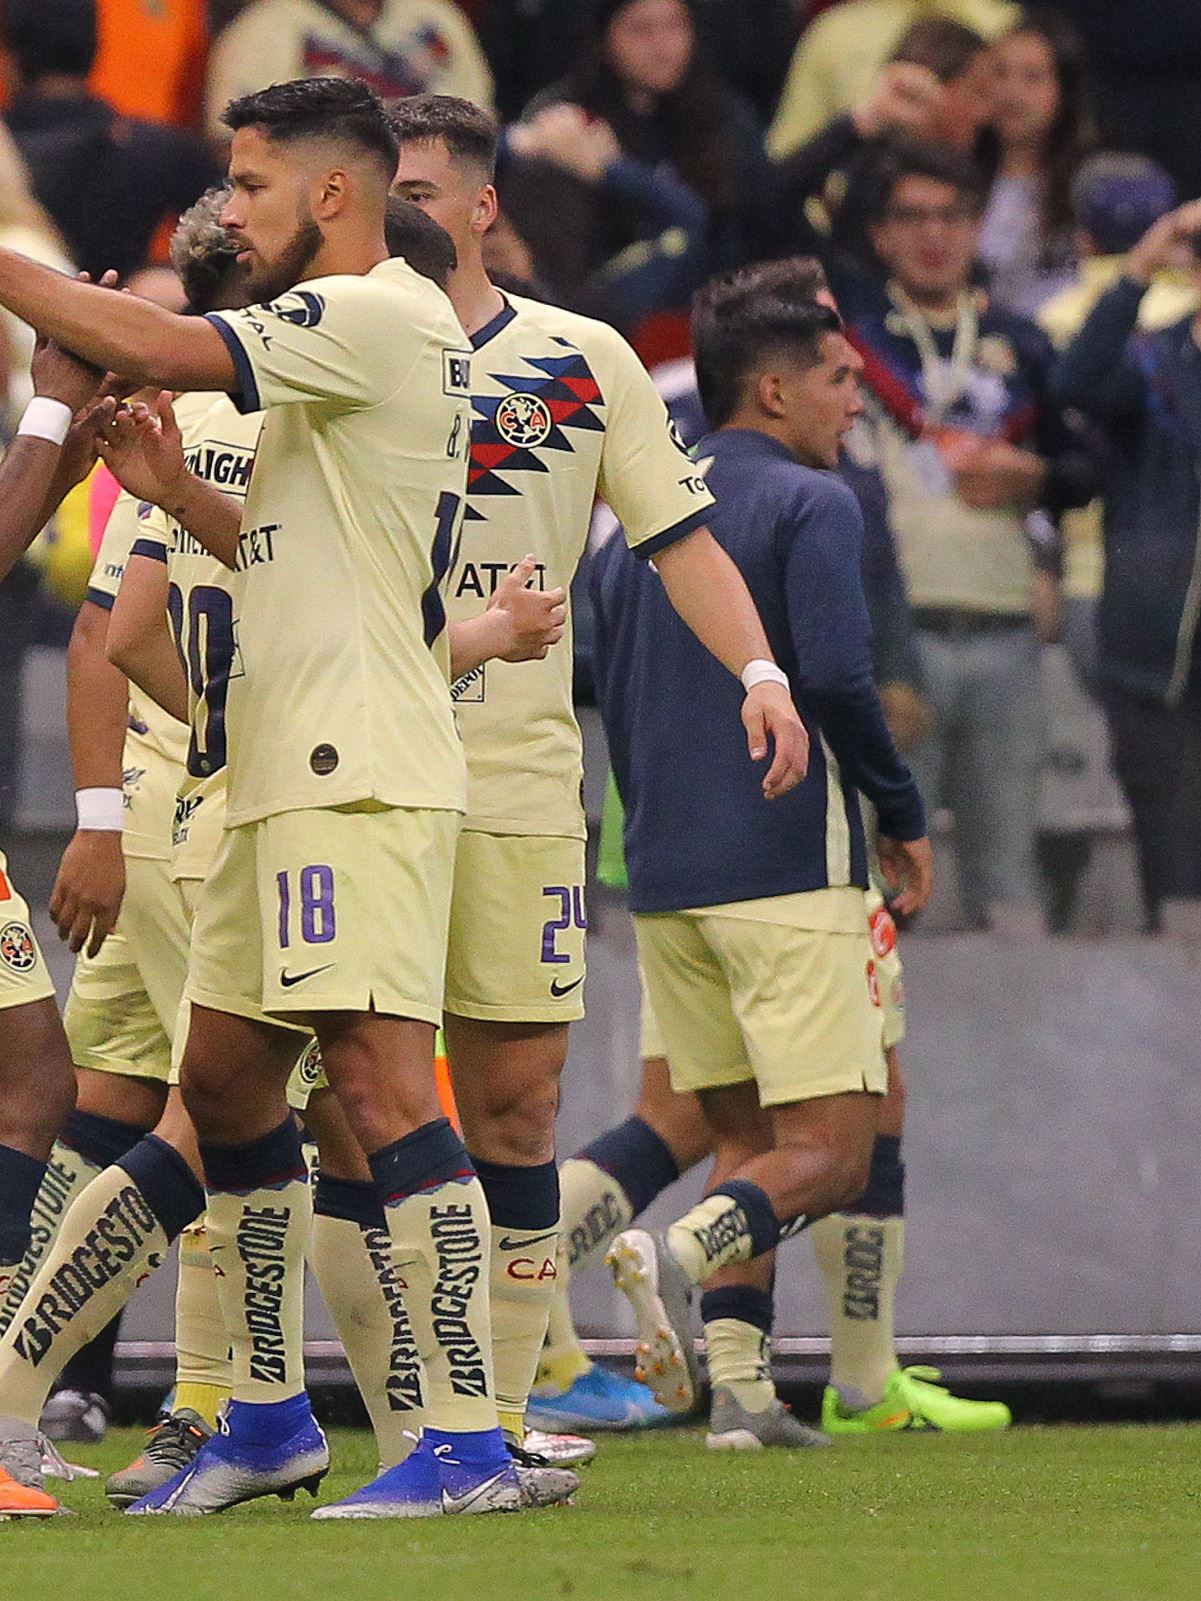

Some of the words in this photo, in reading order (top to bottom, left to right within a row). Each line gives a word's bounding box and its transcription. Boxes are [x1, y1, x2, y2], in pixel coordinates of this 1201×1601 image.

[276, 864, 336, 949] 18
[237, 1204, 290, 1384] BRIDGESTONE
[429, 1203, 489, 1397] BRIDGESTONE
[506, 1257, 558, 1280] CA
